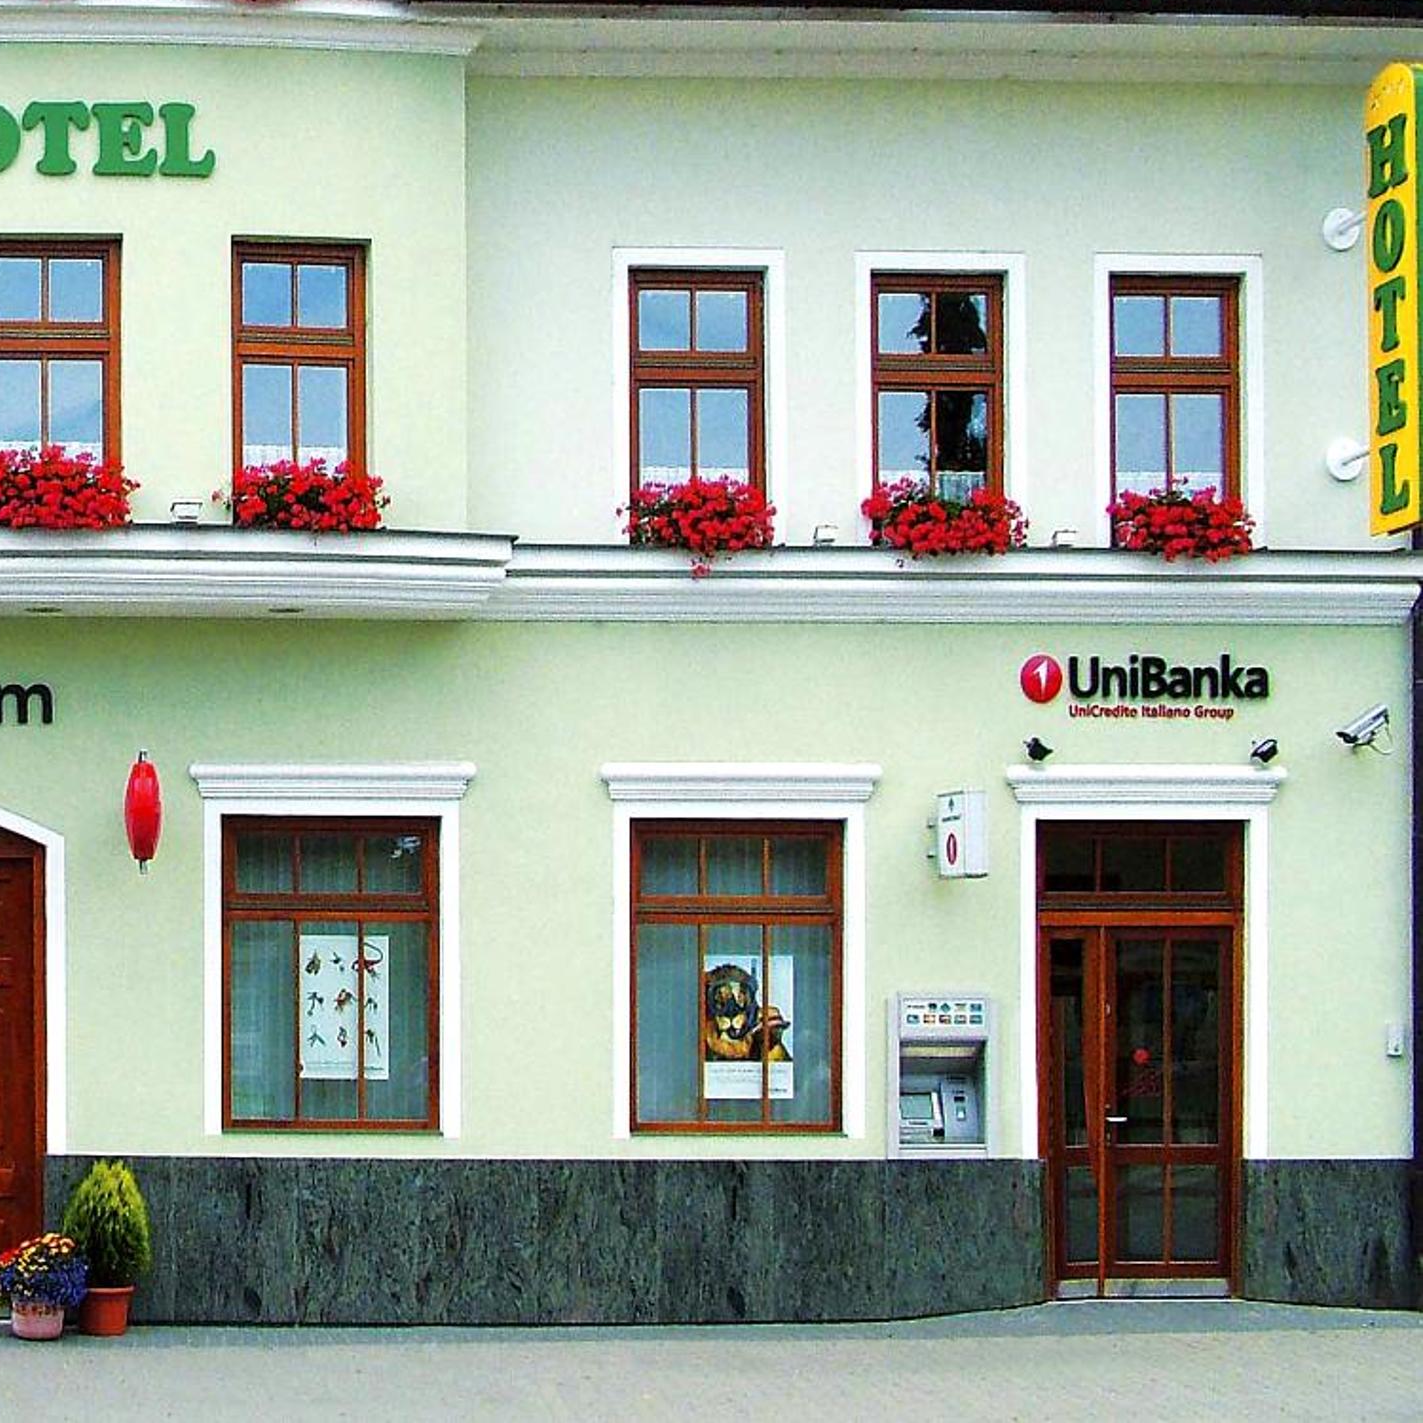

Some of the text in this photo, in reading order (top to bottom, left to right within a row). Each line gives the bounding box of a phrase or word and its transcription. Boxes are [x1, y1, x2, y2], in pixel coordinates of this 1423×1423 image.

[1367, 112, 1410, 516] HOTEL
[1068, 654, 1269, 699] UniBanka
[1068, 704, 1234, 721] UniCredito Italiano Group
